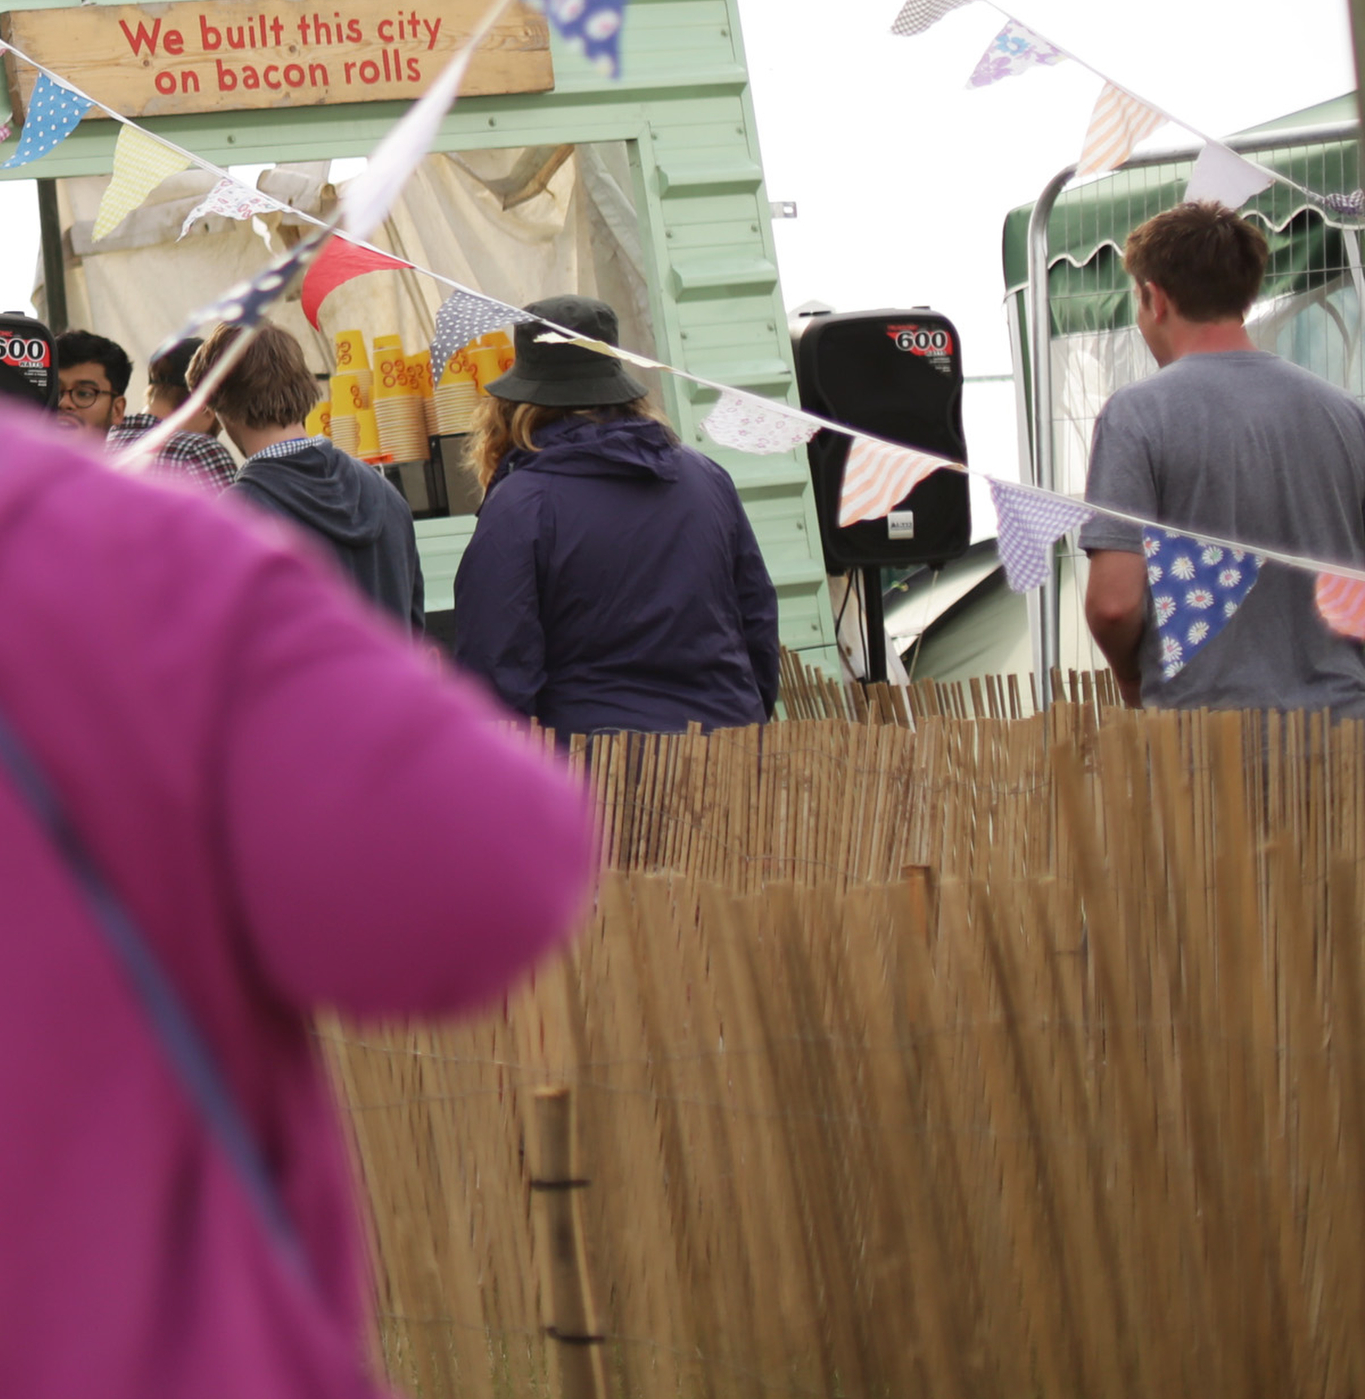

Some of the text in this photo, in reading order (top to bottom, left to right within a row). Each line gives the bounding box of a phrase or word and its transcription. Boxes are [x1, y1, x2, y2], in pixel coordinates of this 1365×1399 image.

[118, 10, 442, 56] We built this city
[153, 48, 421, 95] on bacon rolls
[895, 330, 948, 351] 600
